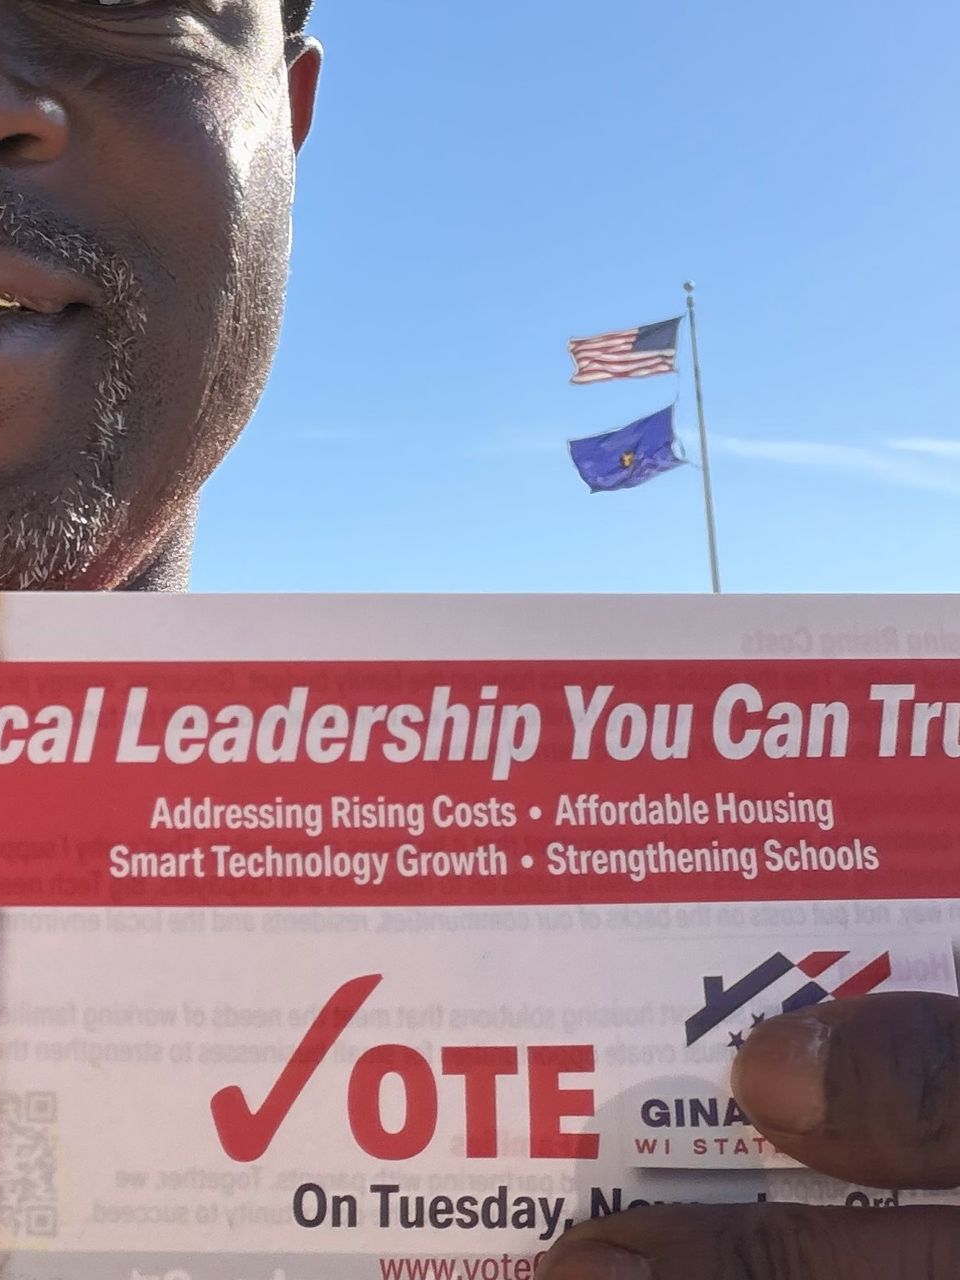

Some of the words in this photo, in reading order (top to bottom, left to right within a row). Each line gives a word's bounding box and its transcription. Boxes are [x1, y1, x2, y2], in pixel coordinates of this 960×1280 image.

[115, 685, 542, 781] Leadership
[562, 684, 695, 761] You
[711, 682, 851, 761] Can
[149, 796, 324, 837] Addressing
[330, 795, 426, 836] Rising
[432, 794, 518, 830] Costs
[554, 792, 709, 827] Affordable
[715, 791, 835, 831] Housing
[108, 844, 204, 878] Smart
[210, 844, 388, 886] Technology
[395, 843, 508, 877] Growth
[545, 841, 758, 882] Strengthening
[763, 838, 880, 871] Schools
[641, 1097, 751, 1128] GINA
[634, 1137, 671, 1155] WI
[693, 1137, 782, 1155] STAT
[292, 1182, 358, 1228] On
